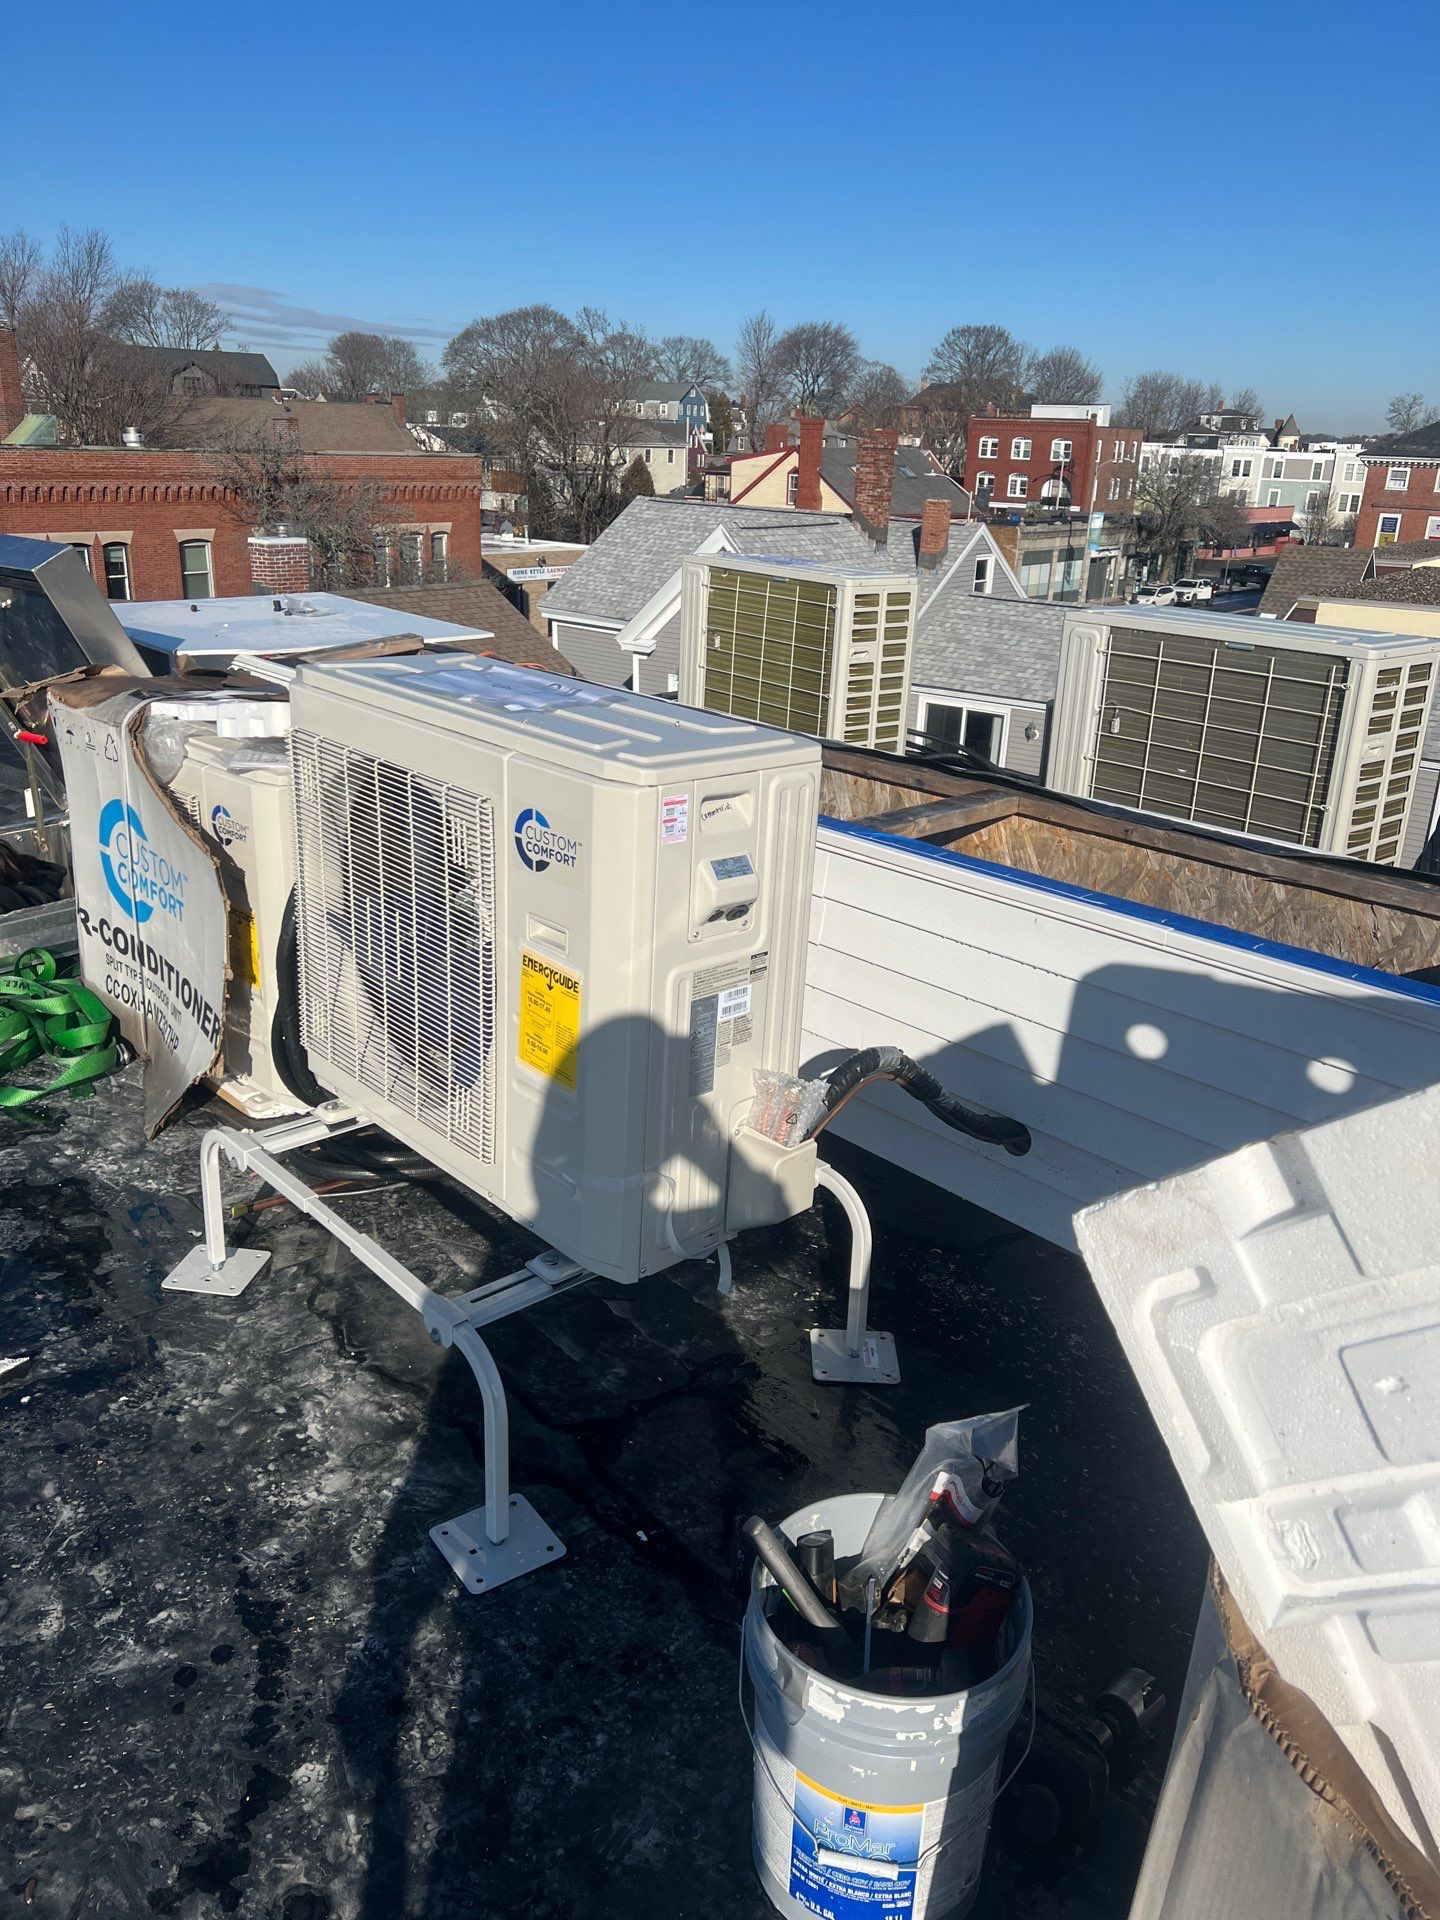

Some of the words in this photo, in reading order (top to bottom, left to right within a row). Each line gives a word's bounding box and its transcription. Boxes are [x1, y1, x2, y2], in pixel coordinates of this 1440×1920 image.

[218, 826, 247, 843] COMFORT
[526, 841, 577, 868] COMFORT
[118, 861, 184, 922] COMFORT
[105, 953, 123, 974] SPLIT
[813, 1819, 896, 1855] ProMar
[793, 1858, 808, 1874] EXTRA
[829, 1881, 847, 1893] EXTRA
[847, 1888, 870, 1898] BLANCO
